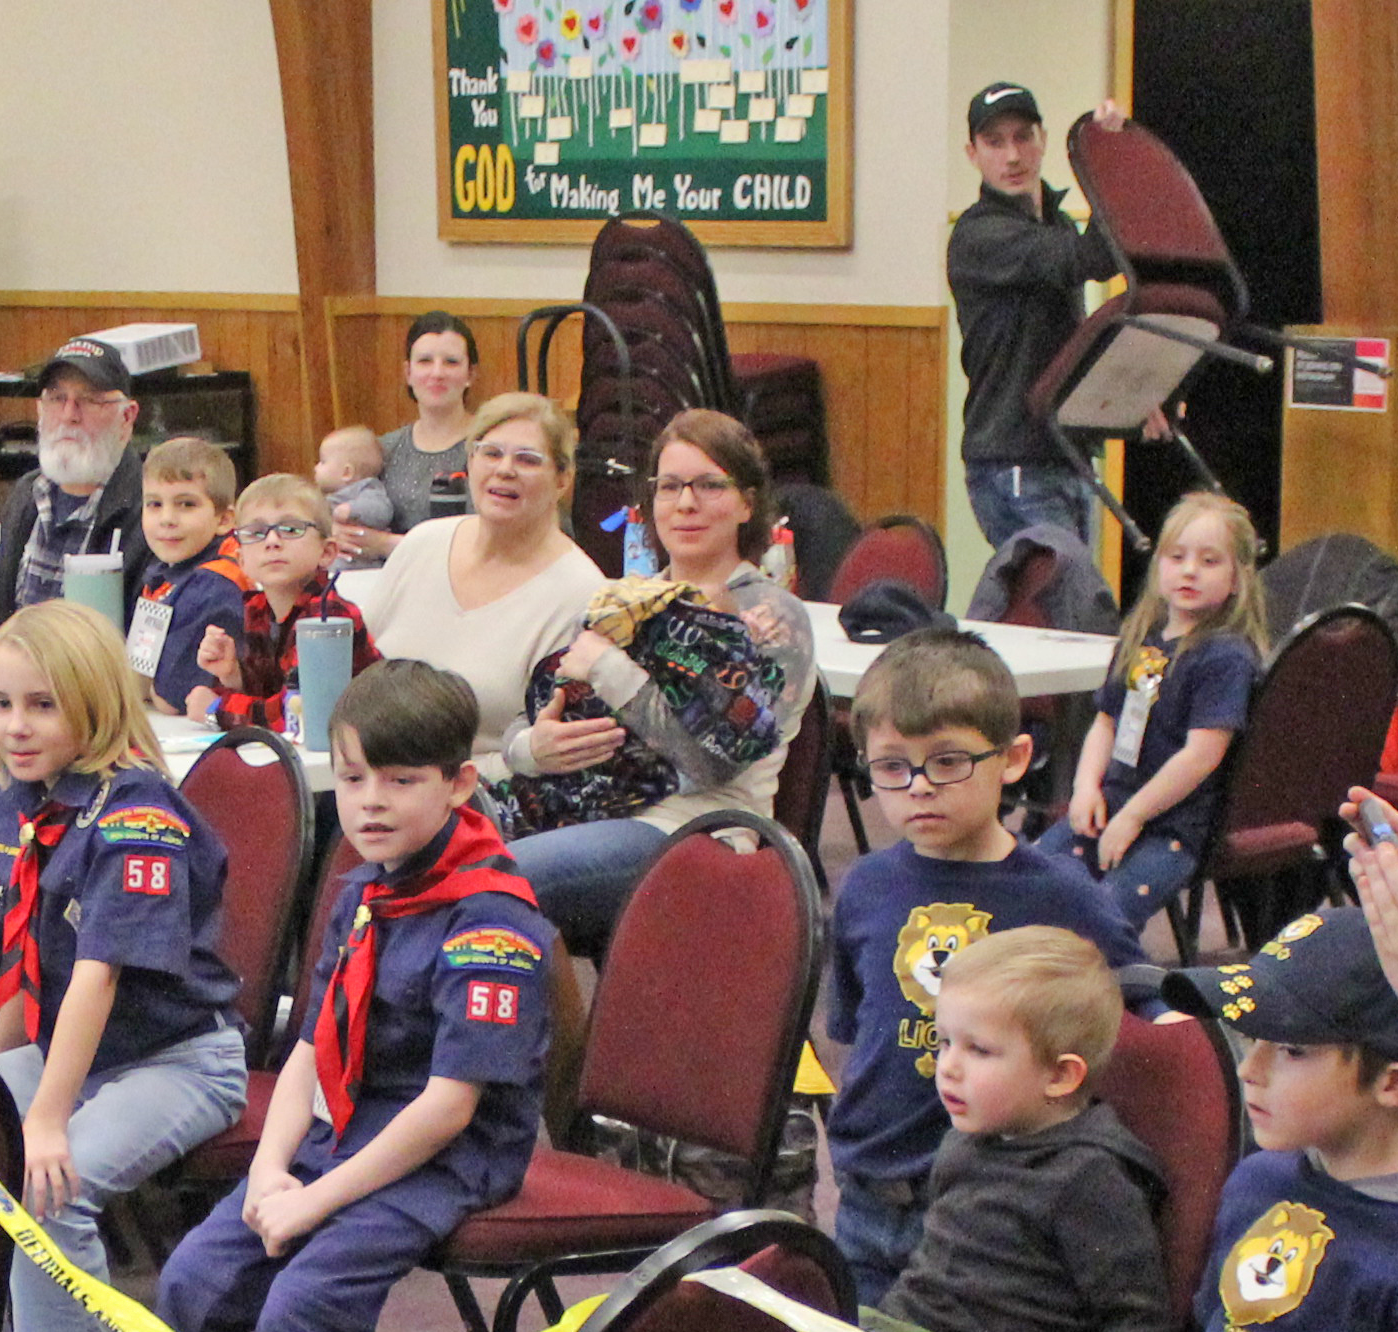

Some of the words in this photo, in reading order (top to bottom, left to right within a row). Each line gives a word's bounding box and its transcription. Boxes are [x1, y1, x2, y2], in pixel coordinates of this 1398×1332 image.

[449, 66, 499, 97] Thank
[471, 99, 499, 128] You
[454, 143, 516, 213] GOD
[524, 164, 547, 195] for
[549, 171, 620, 216] Making
[632, 173, 667, 209] Me
[674, 174, 722, 210] Your
[733, 174, 812, 211] CHILD
[128, 860, 167, 890] 58
[471, 985, 515, 1018] 58
[898, 1018, 941, 1050] LIO
